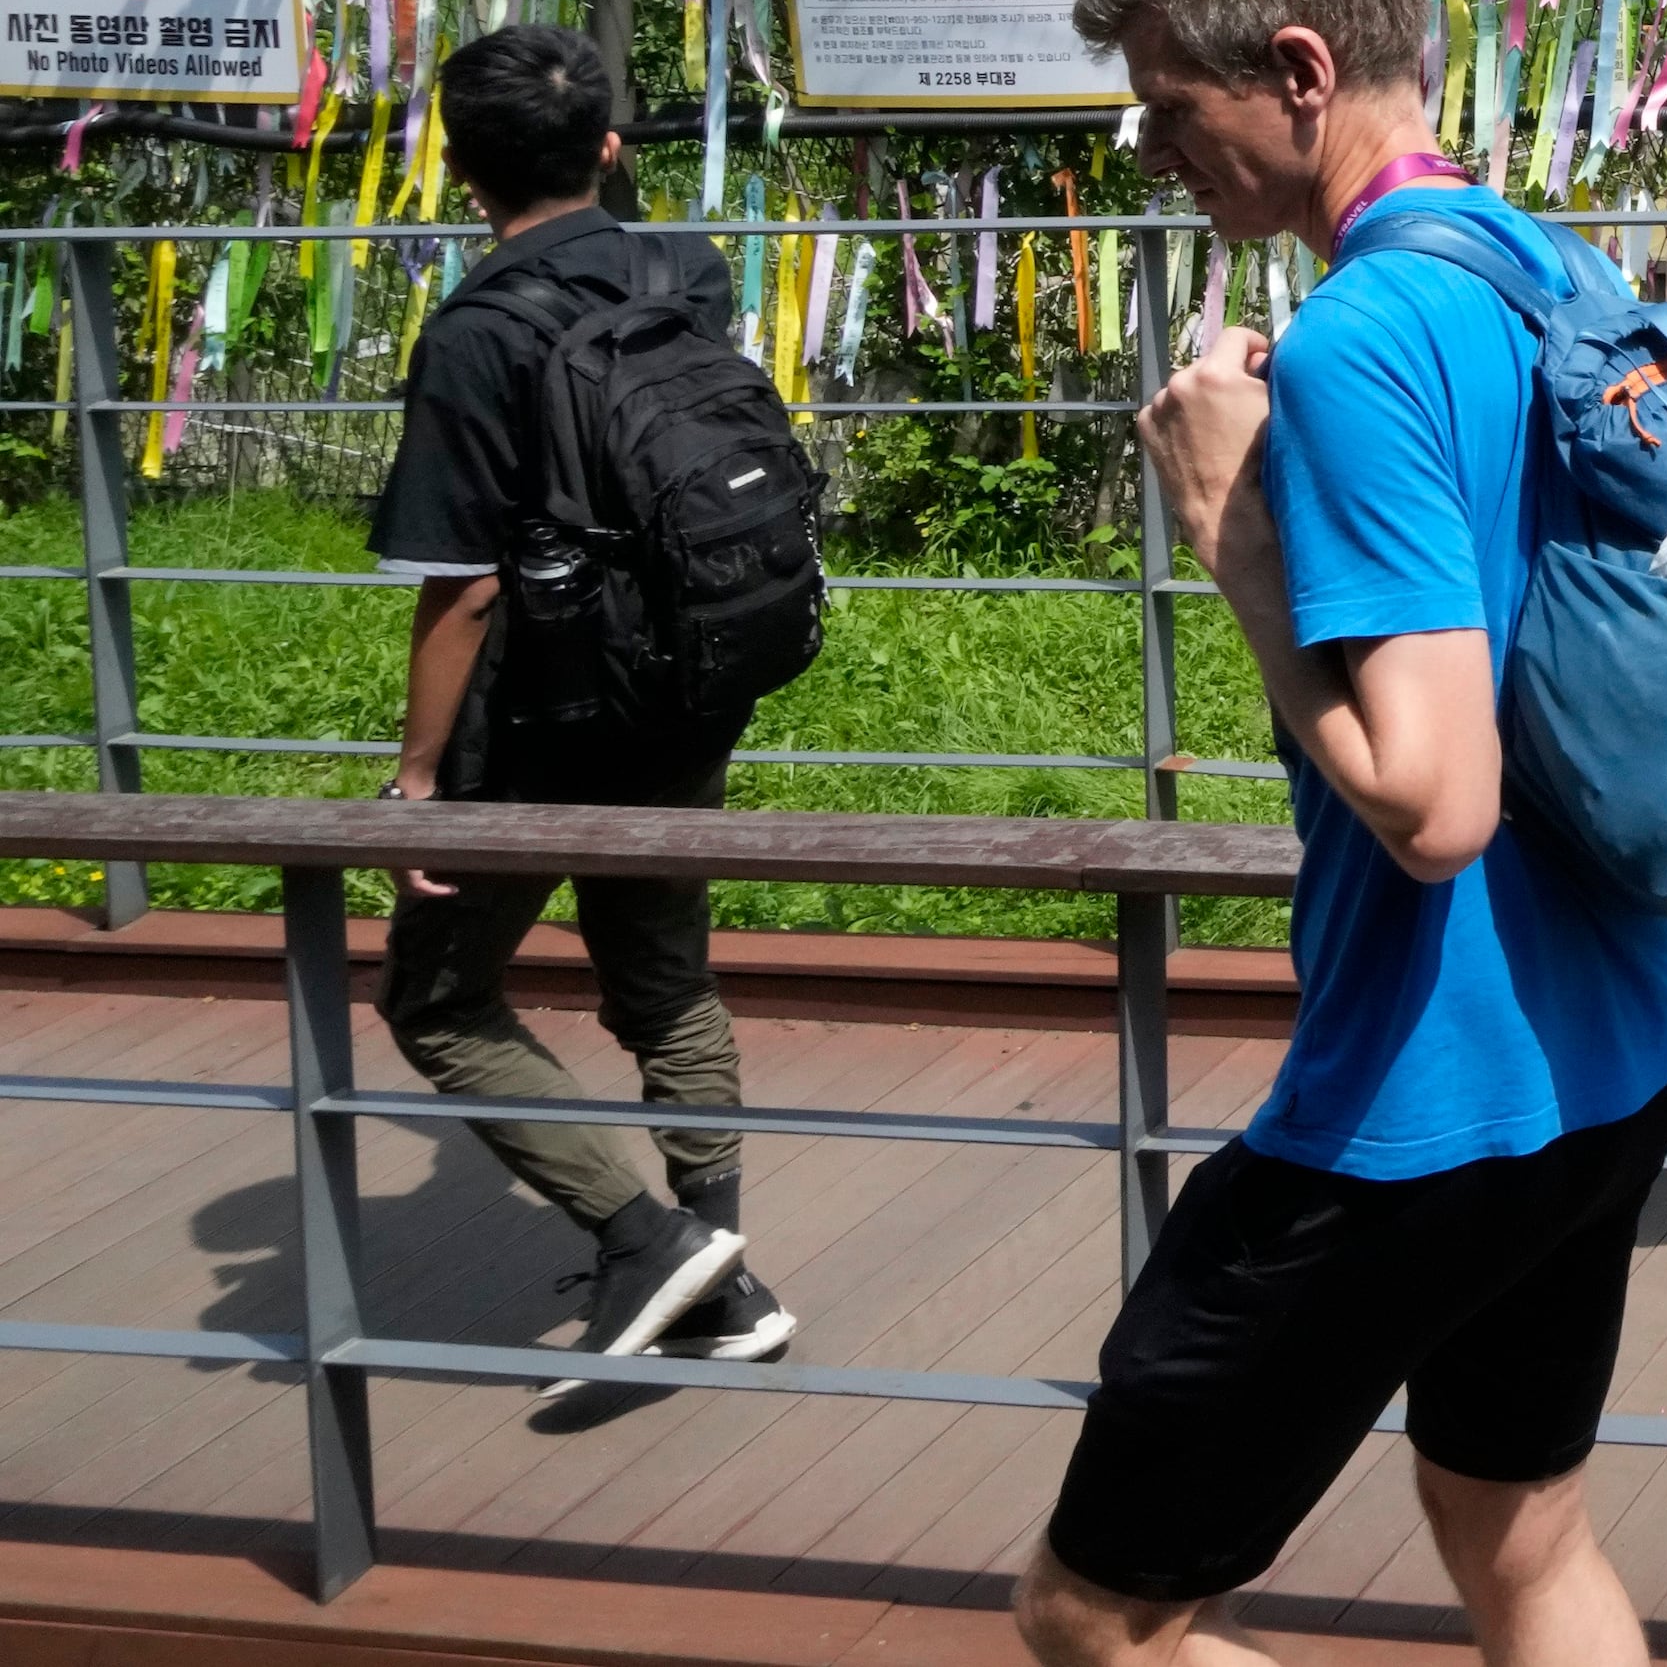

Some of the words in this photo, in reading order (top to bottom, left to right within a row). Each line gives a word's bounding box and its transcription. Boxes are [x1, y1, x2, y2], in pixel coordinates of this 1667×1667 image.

[8, 13, 59, 44] 사진
[69, 14, 149, 45] 동영상
[160, 16, 213, 47] 촬영
[224, 18, 281, 49] 금지
[28, 51, 50, 71] No
[57, 52, 109, 74] Photo
[114, 53, 179, 76] Videos
[185, 54, 263, 77] Allowed
[917, 71, 931, 86] 제
[933, 71, 973, 86] 2258
[975, 71, 1017, 85] 부대장
